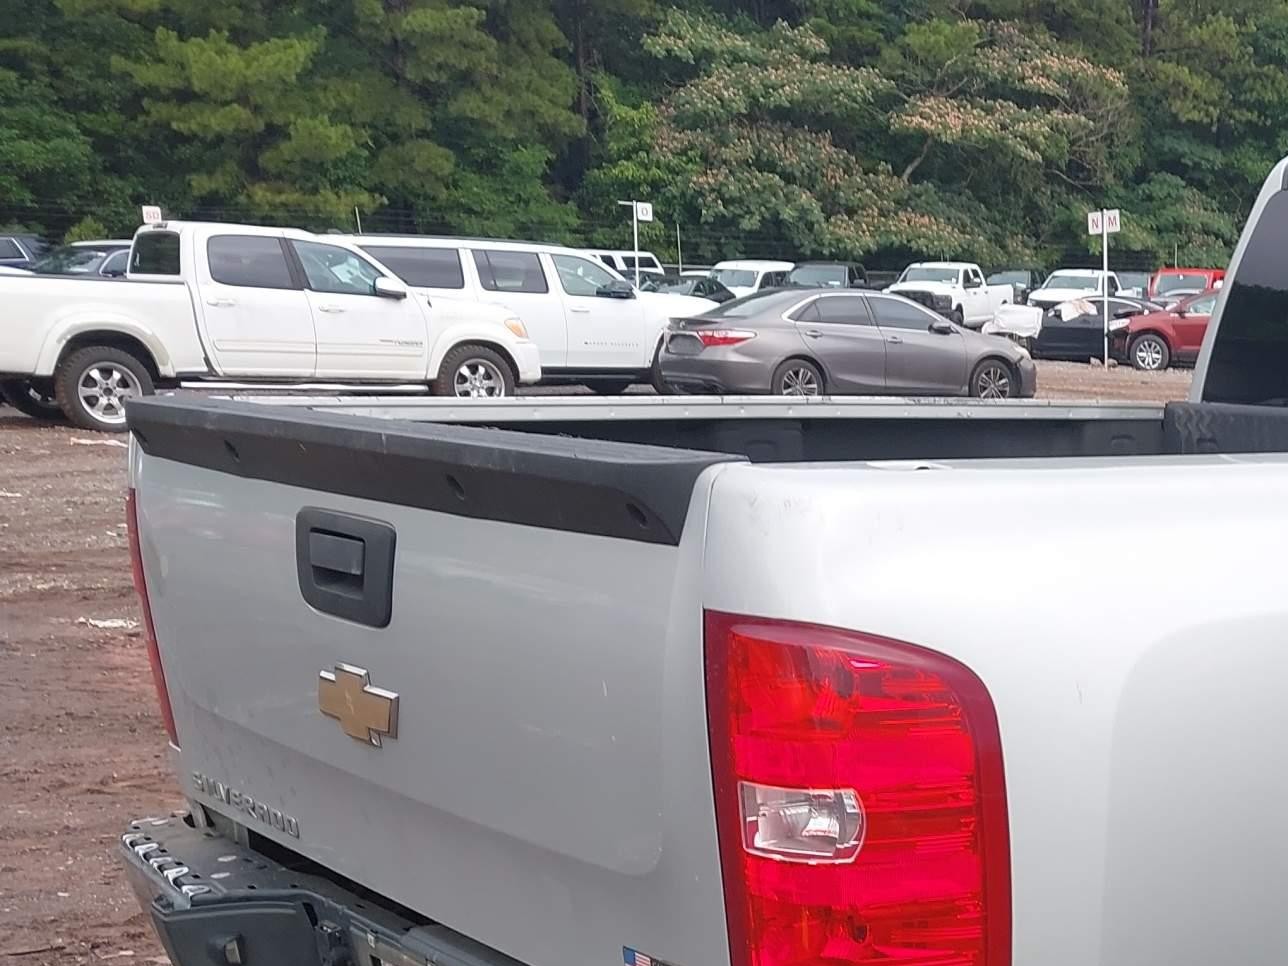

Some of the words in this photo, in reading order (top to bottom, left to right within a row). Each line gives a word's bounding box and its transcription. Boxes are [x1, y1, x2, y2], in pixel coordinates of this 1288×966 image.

[1091, 216, 1099, 229] N
[1107, 215, 1117, 228] M
[193, 771, 300, 839] SILVERADO
